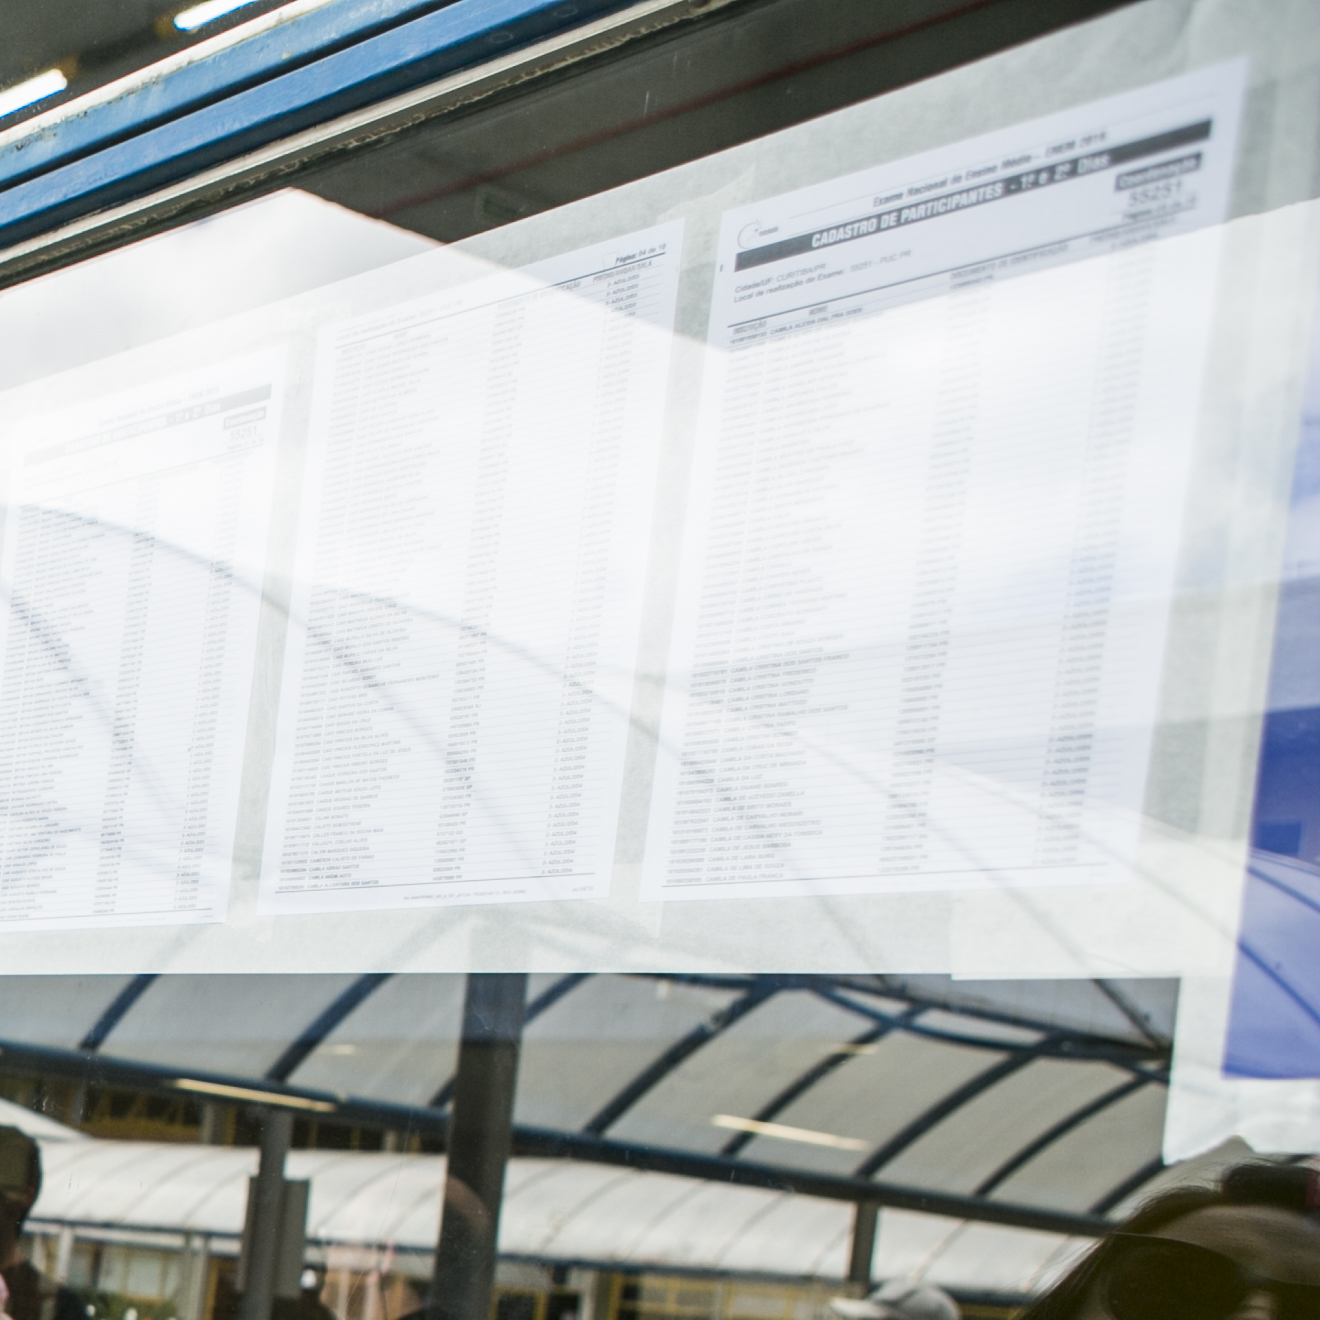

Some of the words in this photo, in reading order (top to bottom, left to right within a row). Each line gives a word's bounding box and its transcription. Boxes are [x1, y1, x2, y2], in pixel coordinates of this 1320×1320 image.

[811, 216, 877, 248] CADASTRO
[879, 210, 897, 229] DE
[900, 181, 1003, 224] PARTICIPANTES
[1077, 150, 1112, 175] Dias
[873, 189, 903, 207] Exame
[906, 176, 947, 197] Nacional
[733, 290, 753, 303] Local
[755, 287, 764, 297] de
[766, 277, 803, 296] realização
[817, 266, 846, 281] Exame:
[850, 259, 871, 272] 55251
[776, 262, 826, 283] CURITIBA/PR
[230, 425, 257, 441] 55251
